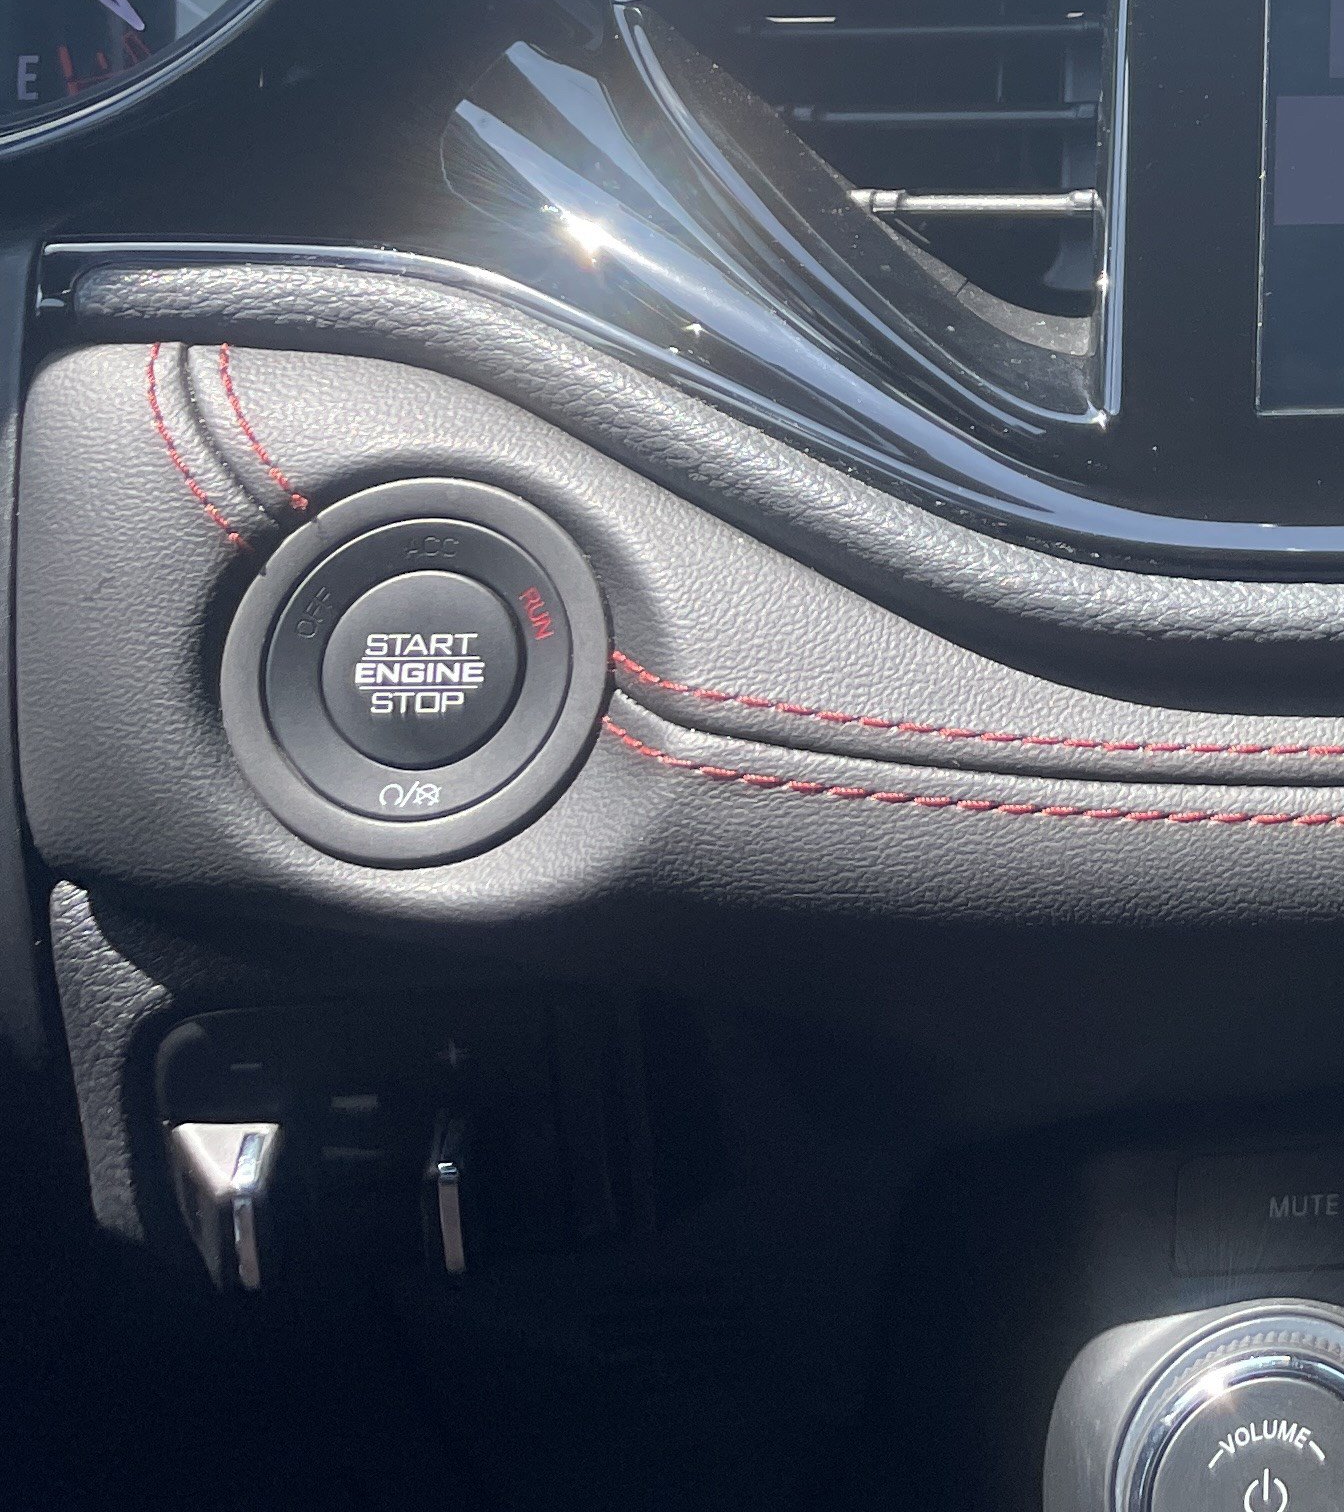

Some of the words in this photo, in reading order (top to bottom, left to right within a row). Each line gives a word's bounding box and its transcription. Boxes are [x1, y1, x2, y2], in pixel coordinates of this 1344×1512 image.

[15, 54, 41, 101] E
[294, 585, 335, 640] OFF
[517, 585, 556, 642] RUN
[364, 632, 478, 656] START
[354, 661, 485, 685] ENGINE
[370, 691, 465, 714] STOP
[1268, 1192, 1340, 1220] MUTE
[1220, 1419, 1311, 1452] VOLUME
